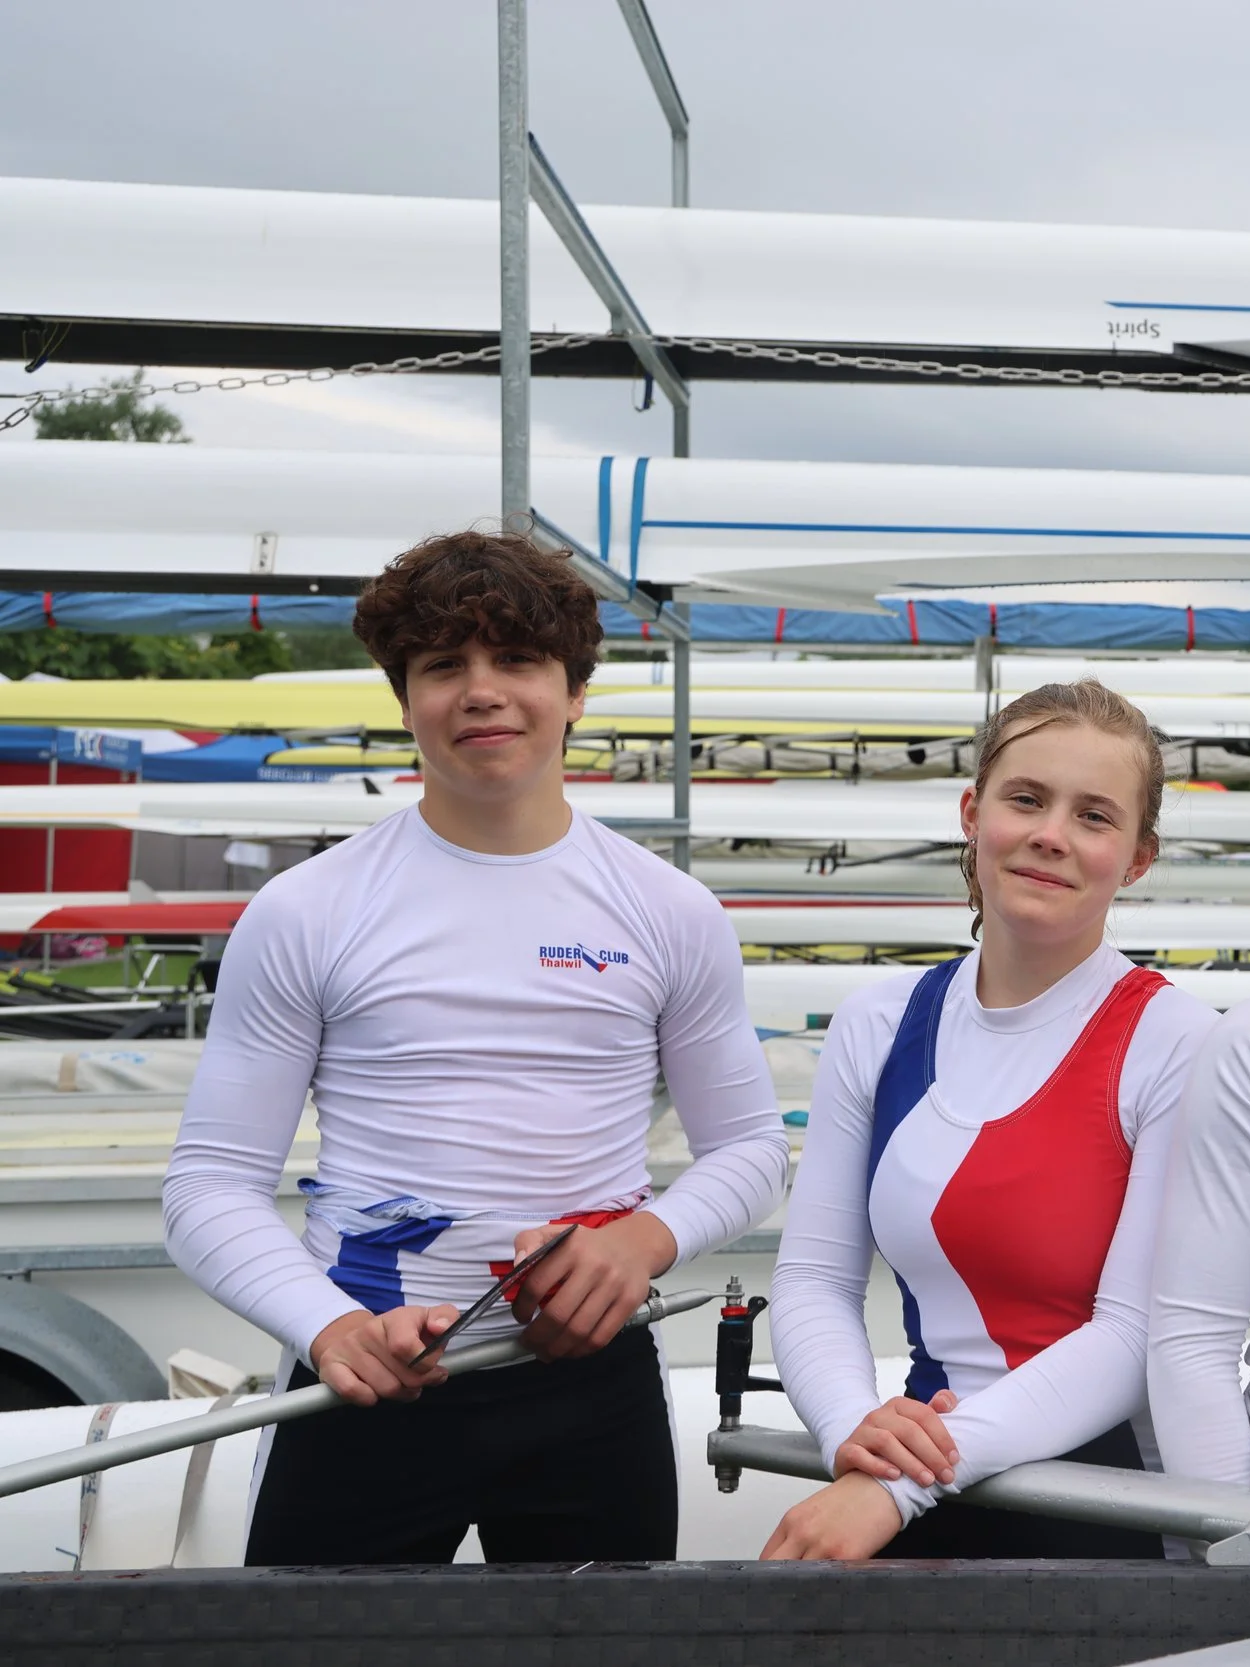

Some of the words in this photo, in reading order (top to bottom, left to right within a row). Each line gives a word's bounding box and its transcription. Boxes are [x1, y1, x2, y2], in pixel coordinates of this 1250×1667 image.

[1107, 319, 1160, 339] Spirit
[539, 946, 581, 960] RUDER
[599, 949, 629, 964] CLUB
[539, 958, 582, 969] Thalwil
